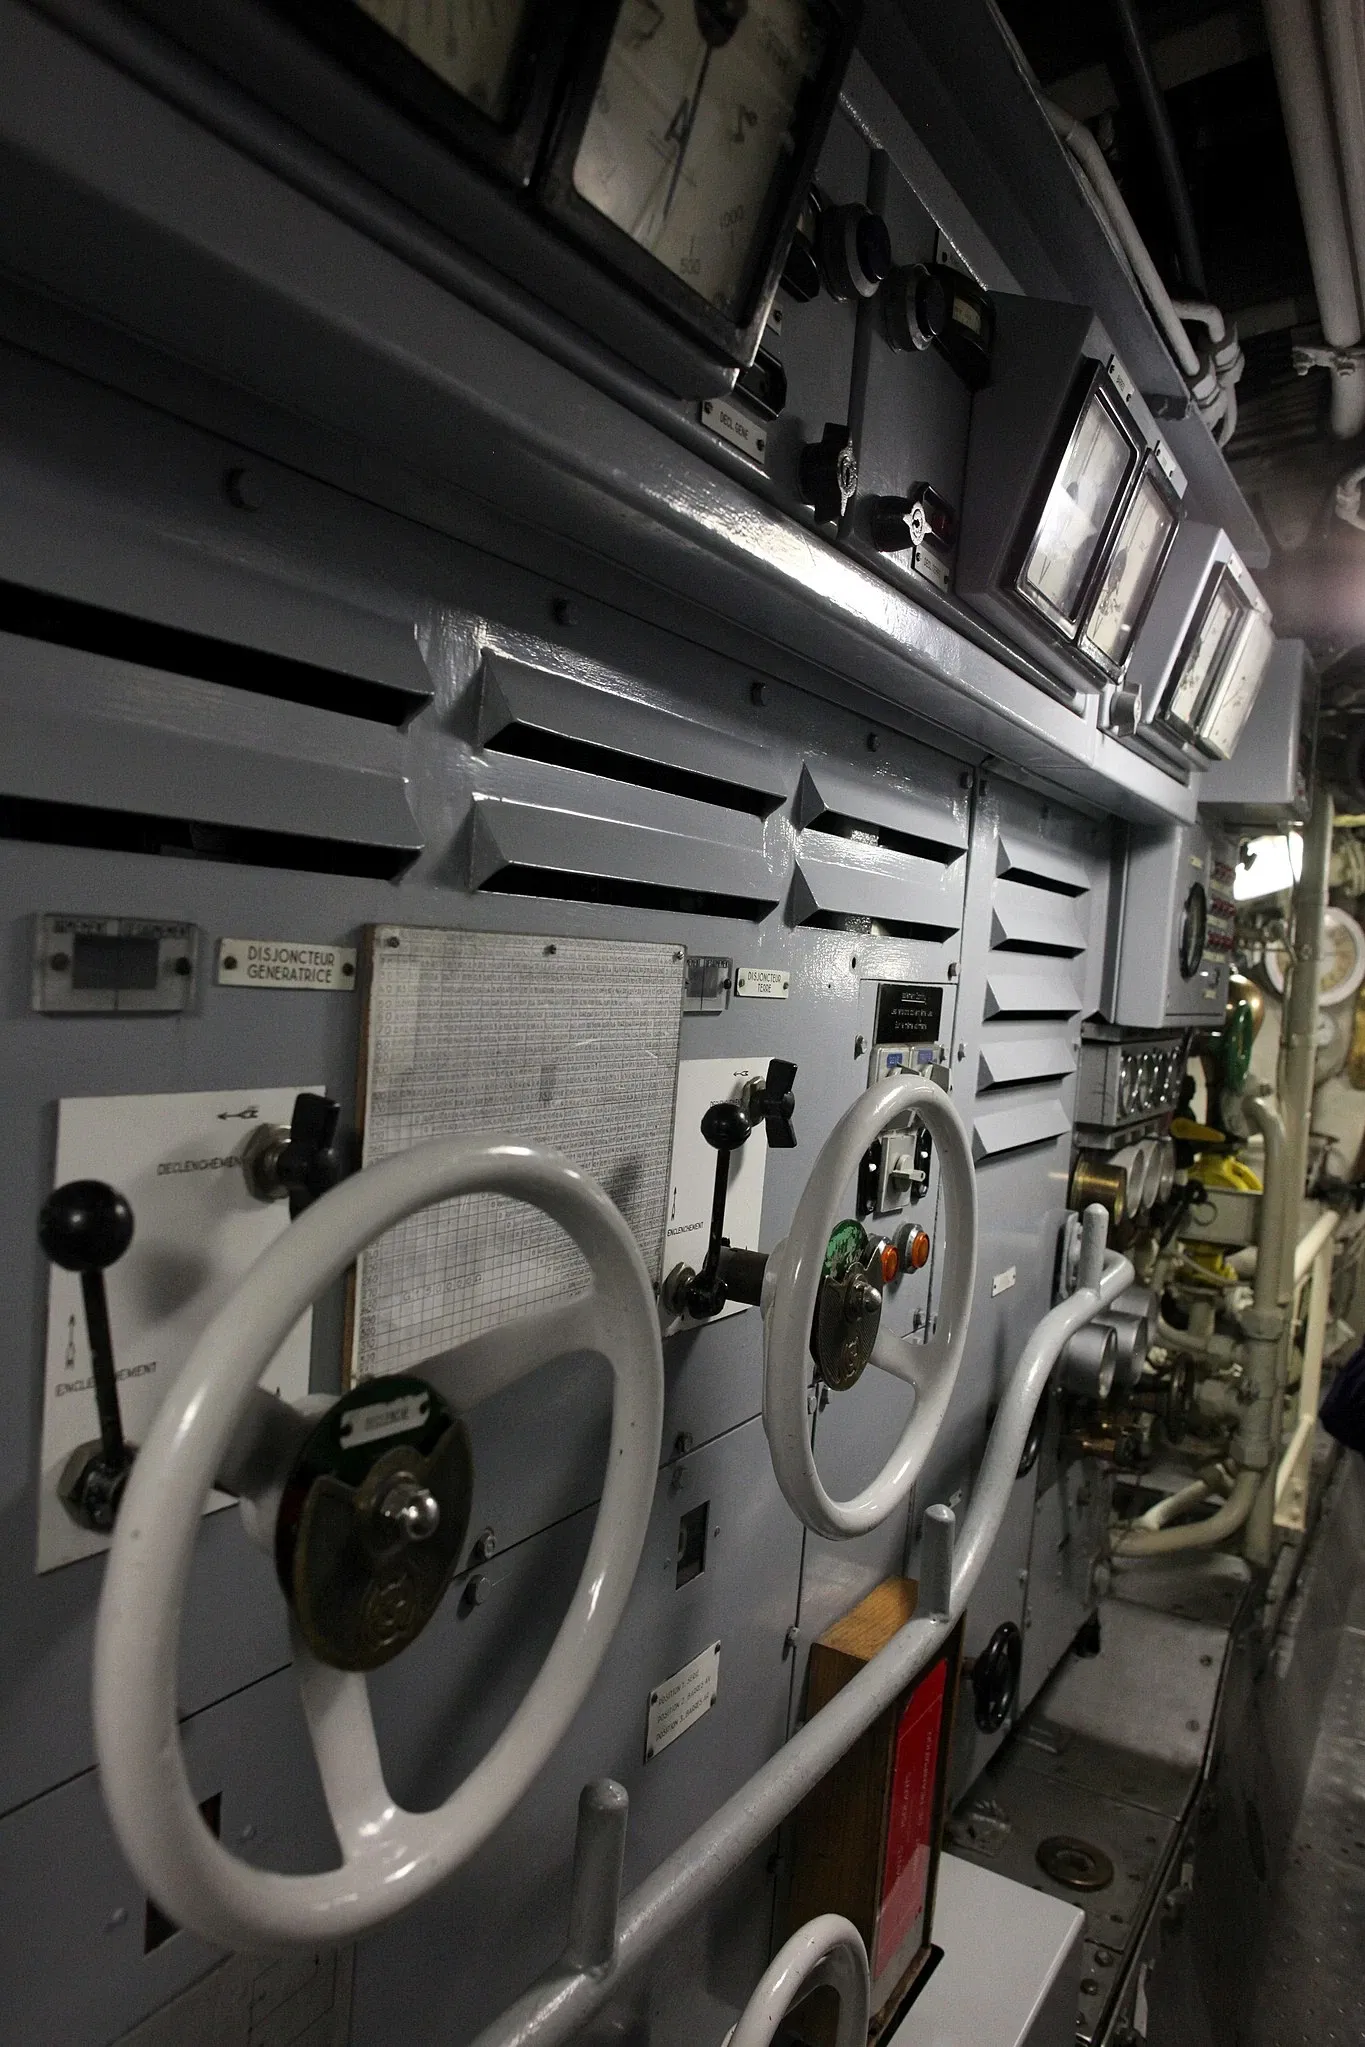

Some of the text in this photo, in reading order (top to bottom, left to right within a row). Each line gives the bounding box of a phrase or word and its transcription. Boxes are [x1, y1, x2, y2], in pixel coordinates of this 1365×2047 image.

[247, 945, 335, 966] DISJONCTEUR
[247, 963, 333, 983] GENERATRICE
[747, 971, 782, 983] DISJONCTEUR
[156, 1155, 244, 1176] DECLENCHEMEN
[667, 1221, 704, 1237] ENCLENCHEMENT
[658, 1685, 681, 1707] POSITION
[657, 1702, 680, 1724] POSITION
[655, 1719, 678, 1742] POSITION
